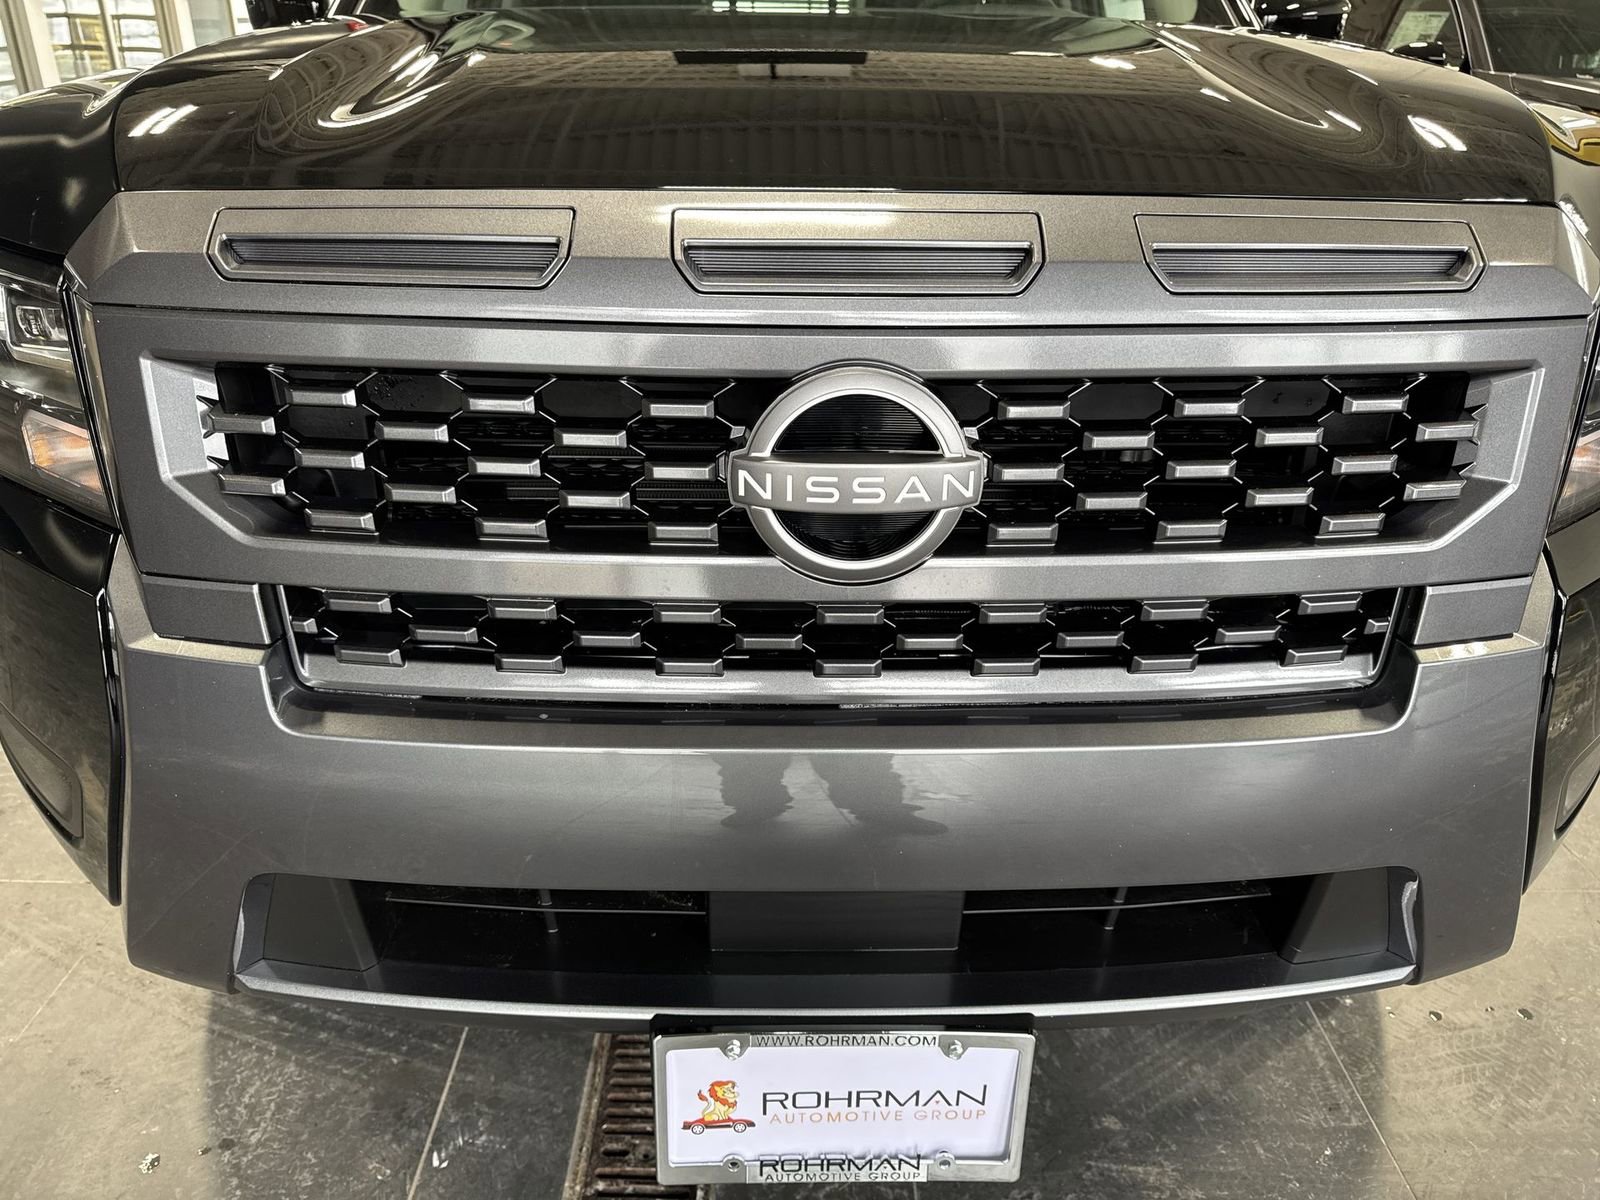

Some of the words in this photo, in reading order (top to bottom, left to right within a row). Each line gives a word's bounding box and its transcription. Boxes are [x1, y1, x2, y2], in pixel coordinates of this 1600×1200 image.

[737, 469, 975, 504] NISSAN
[756, 1035, 938, 1047] WWW.ROHRMAN.COM
[762, 1084, 988, 1116] ROHRMAN
[769, 1110, 904, 1125] AUTOMOTIVE
[915, 1108, 987, 1121] GROUP
[758, 1153, 922, 1177] ROHRMAN
[764, 1172, 866, 1182] AUTOMOTIVE
[868, 1172, 922, 1181] GROUP
